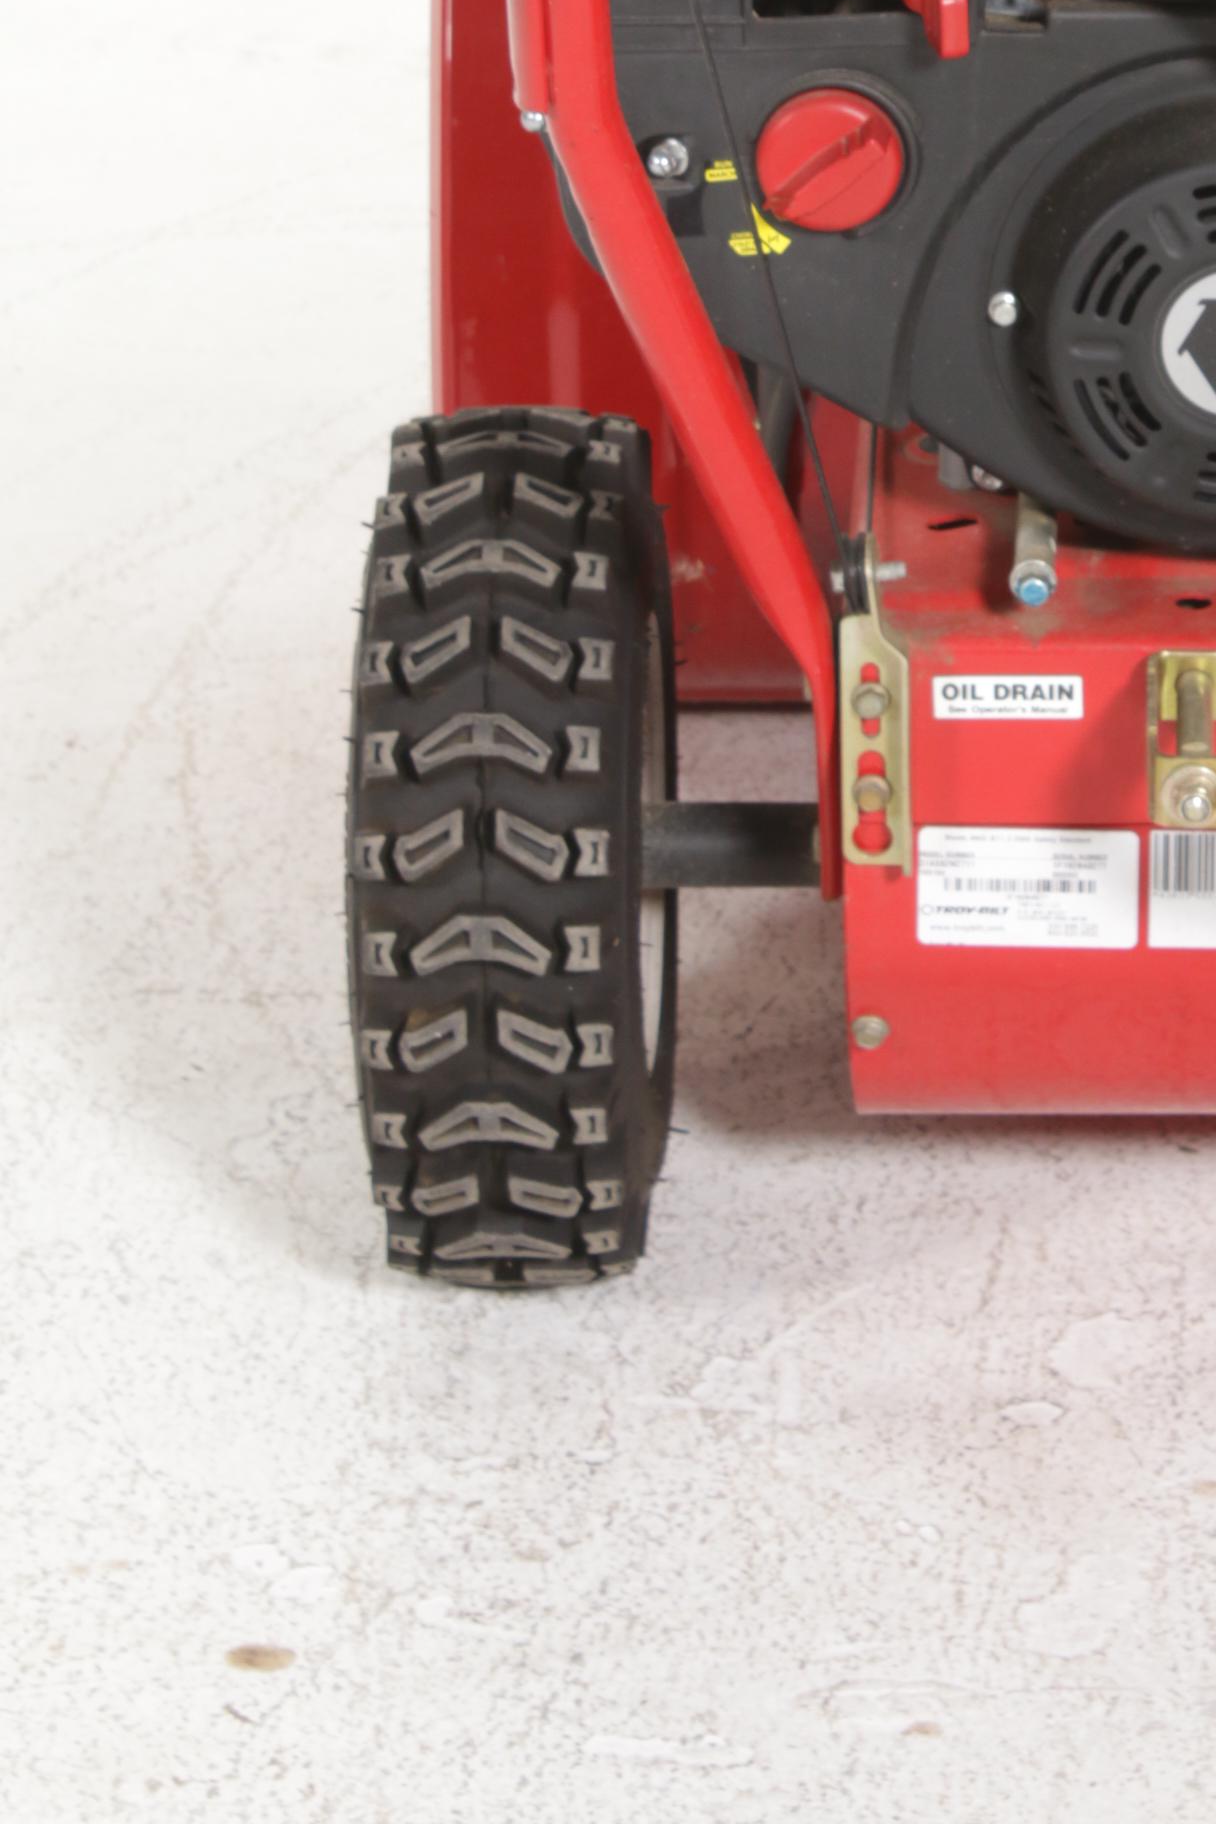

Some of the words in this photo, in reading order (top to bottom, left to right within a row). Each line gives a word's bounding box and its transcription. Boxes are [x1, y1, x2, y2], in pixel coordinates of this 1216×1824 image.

[942, 683, 985, 701] OIL
[993, 683, 1074, 701] DRAIN
[948, 705, 967, 713] See
